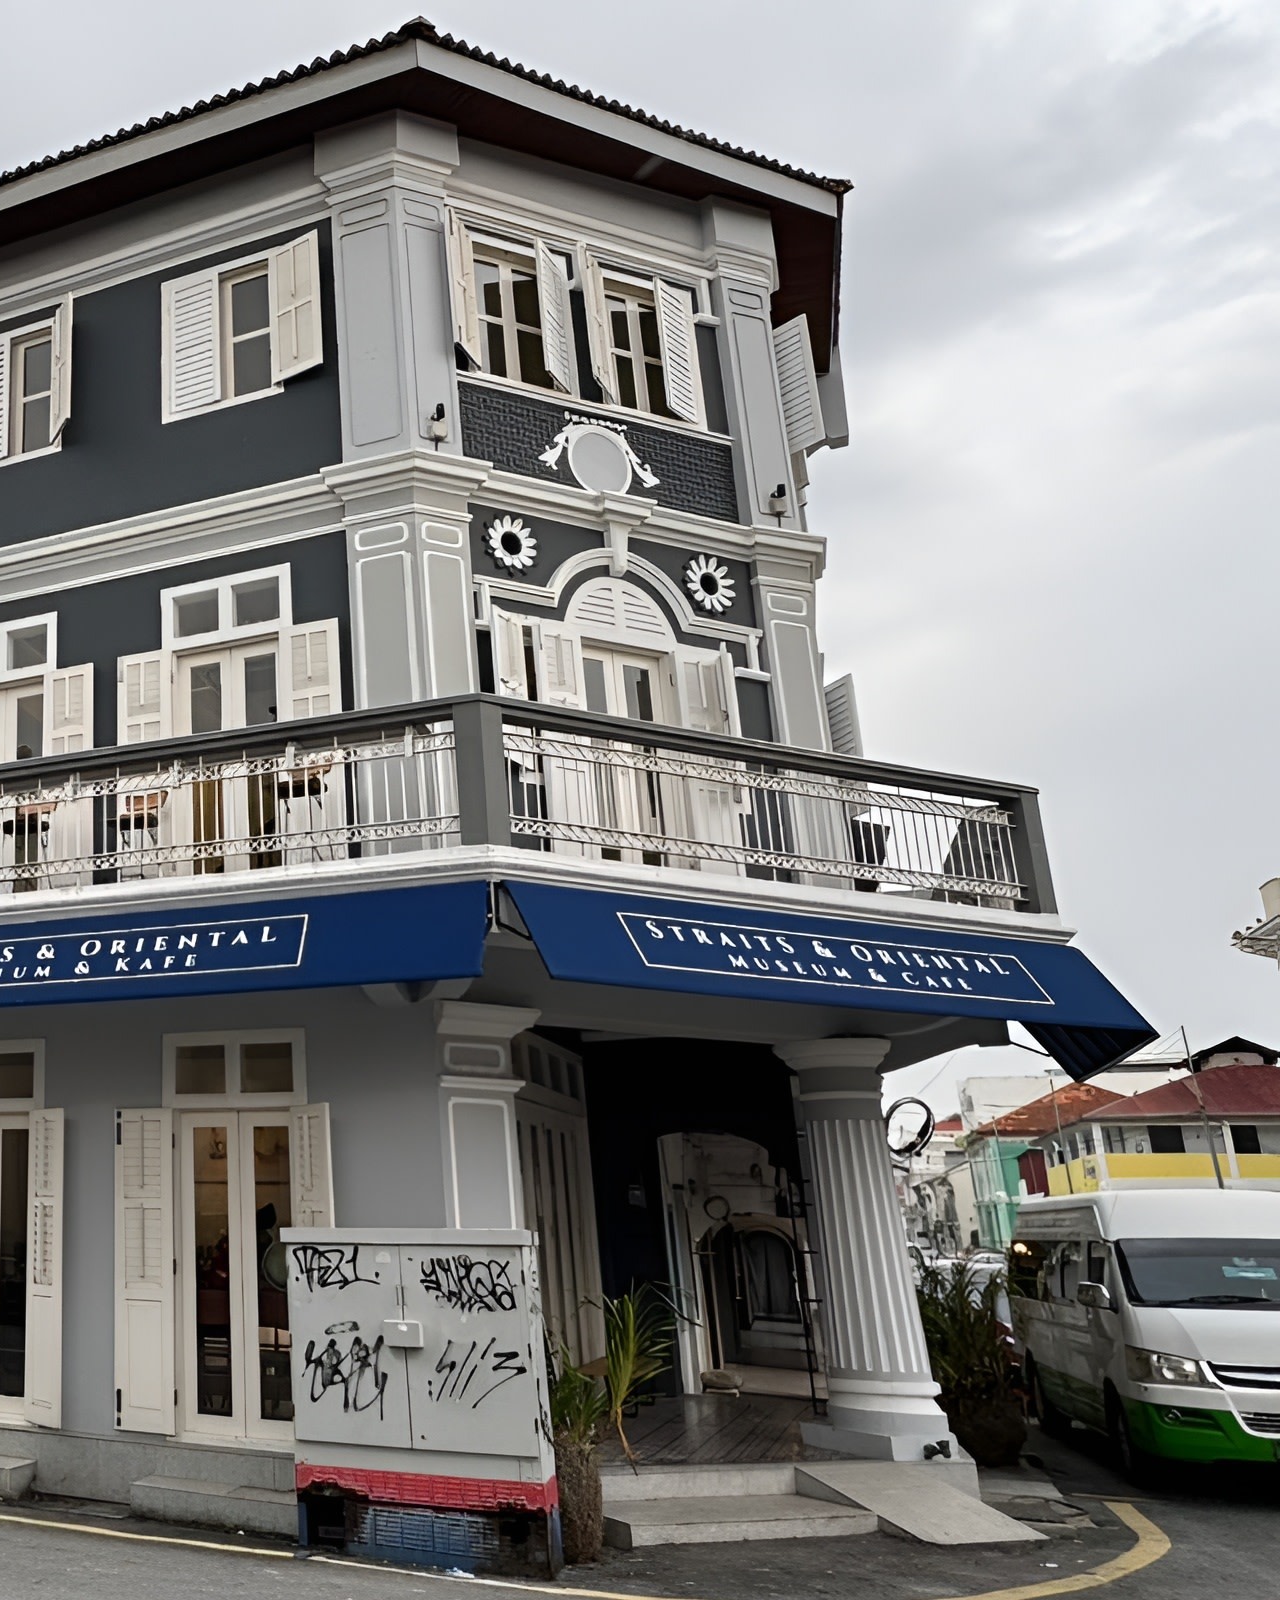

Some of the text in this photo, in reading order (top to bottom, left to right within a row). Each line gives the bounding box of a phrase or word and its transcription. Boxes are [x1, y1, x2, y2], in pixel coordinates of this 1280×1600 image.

[36, 944, 55, 960] &
[80, 926, 276, 956] ORIENTAL
[645, 920, 1010, 975] STRAITS & ORIENTAL
[74, 961, 89, 975] &
[115, 954, 197, 972] KAFE
[728, 954, 852, 979] MUSEUM
[868, 968, 887, 983] &
